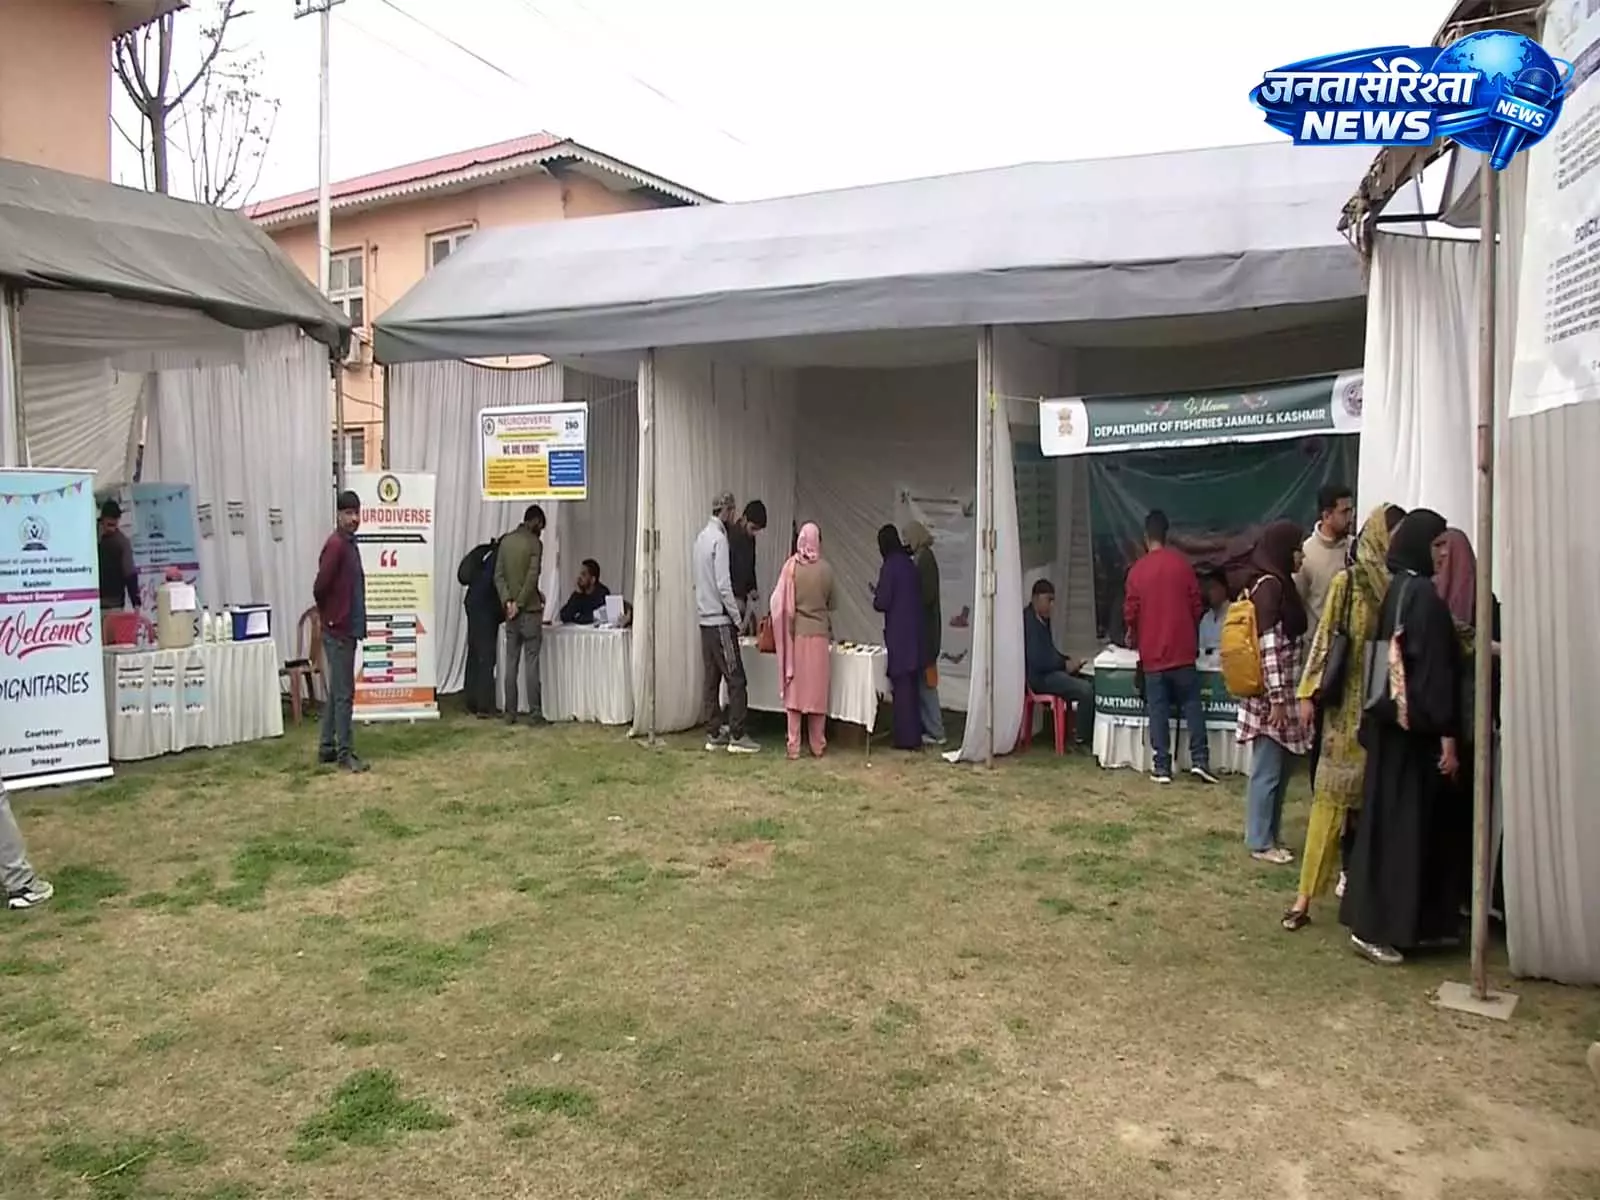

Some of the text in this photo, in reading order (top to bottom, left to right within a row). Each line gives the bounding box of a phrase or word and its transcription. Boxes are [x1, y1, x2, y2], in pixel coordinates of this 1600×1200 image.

[565, 421, 580, 430] ISO
[1094, 409, 1326, 437] DEPARTMENT OF FISHERIES JAMMU & KASHMIR
[362, 509, 431, 523] URODIVERSE
[0, 607, 93, 657] Welcomes
[1095, 695, 1144, 708] PARTMENT
